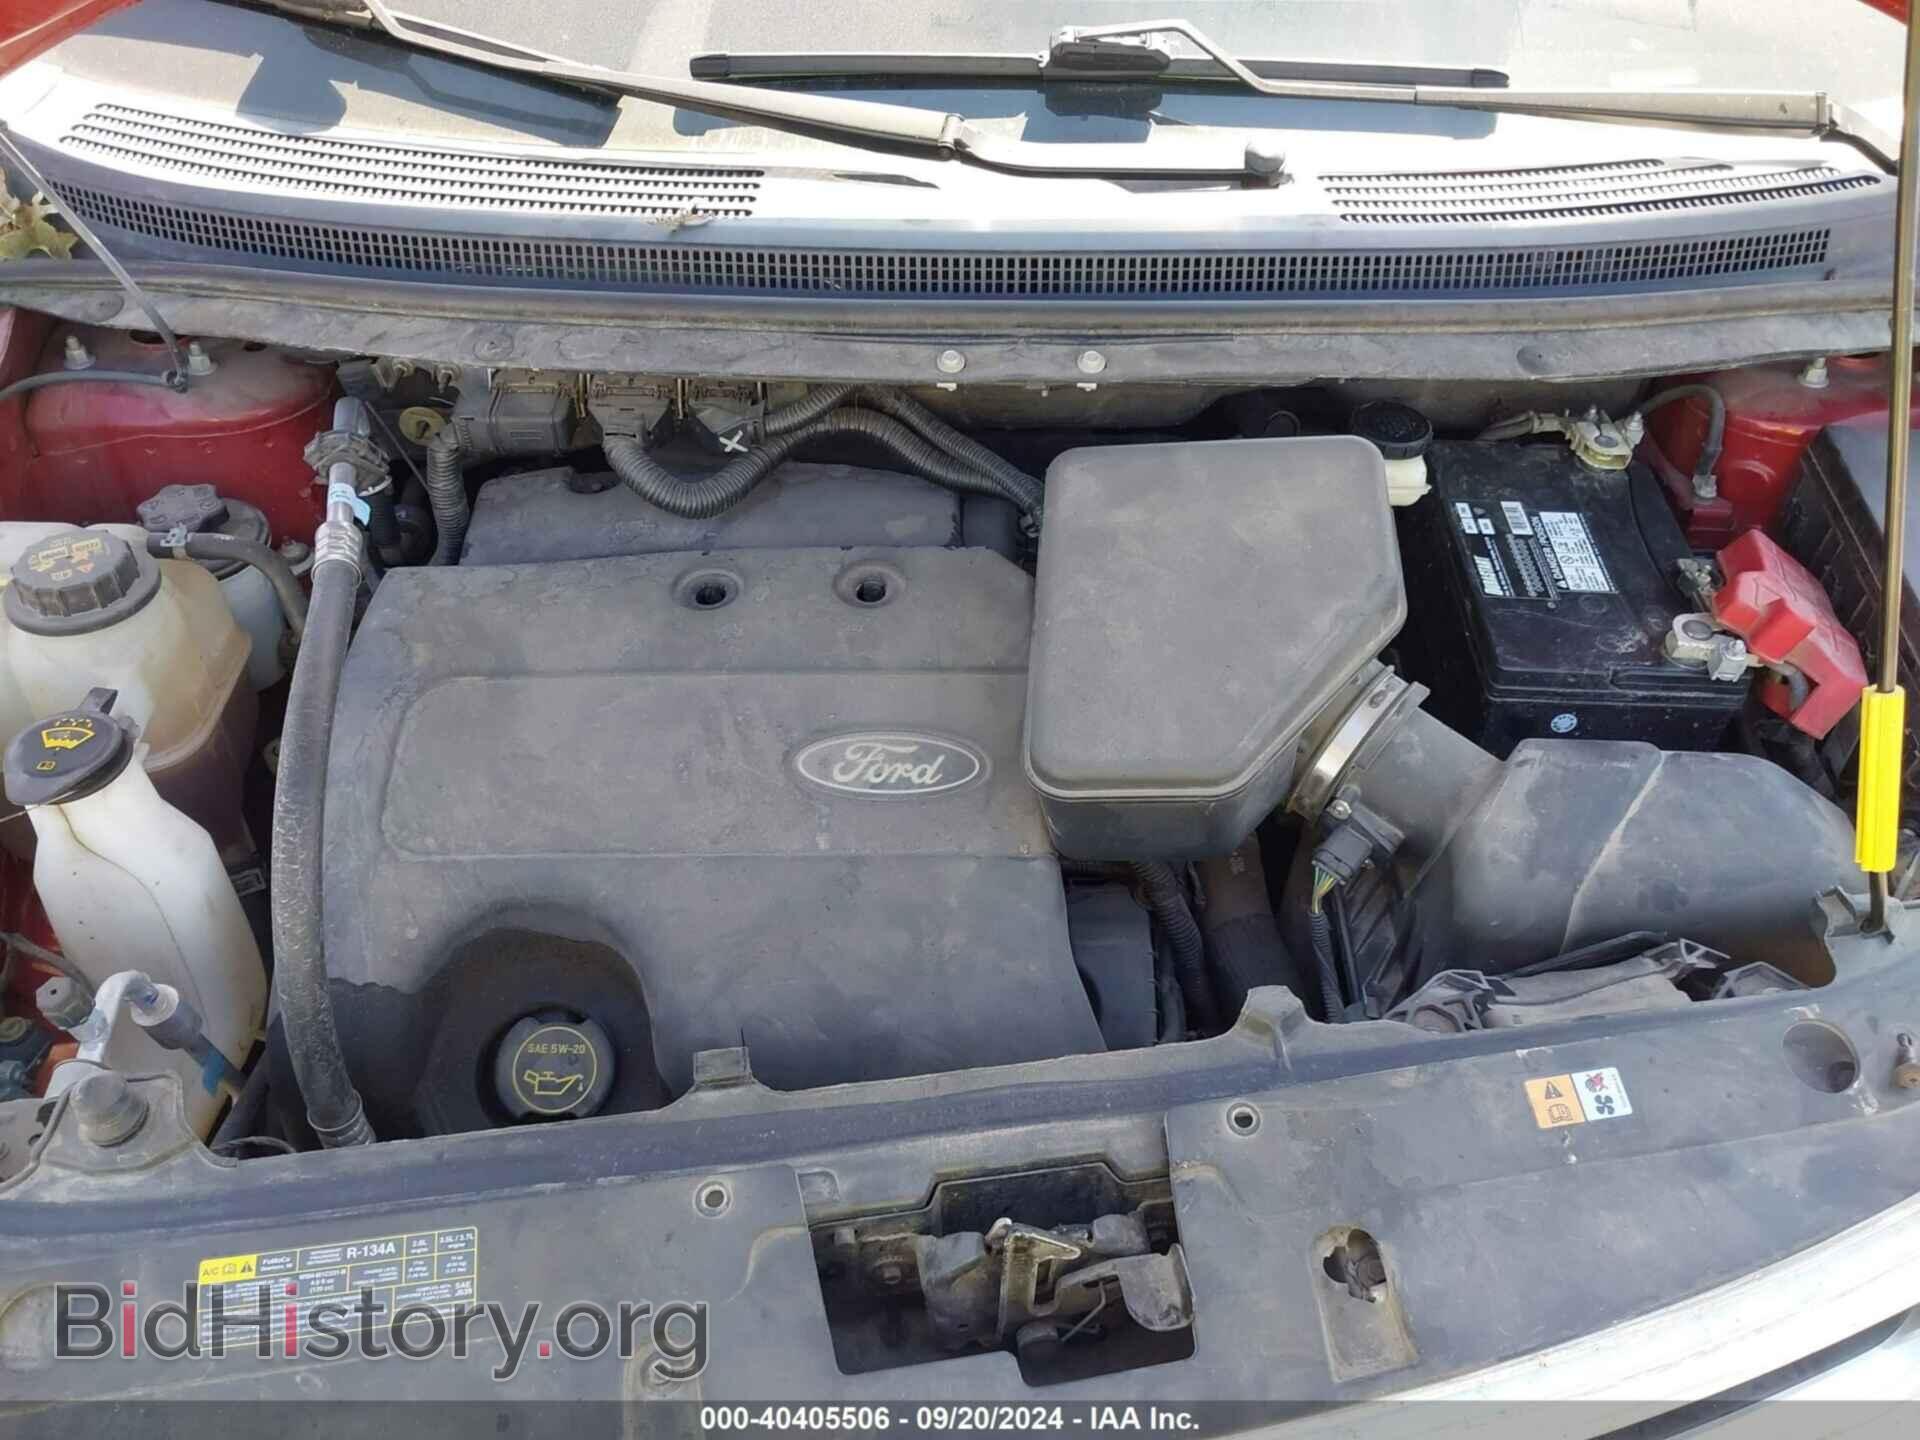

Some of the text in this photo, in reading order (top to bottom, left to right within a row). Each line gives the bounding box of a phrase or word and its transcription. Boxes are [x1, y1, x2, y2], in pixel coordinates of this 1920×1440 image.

[833, 742, 945, 784] Ford
[528, 1043, 586, 1054] SAE 5W-20
[346, 1242, 396, 1259] R-134A
